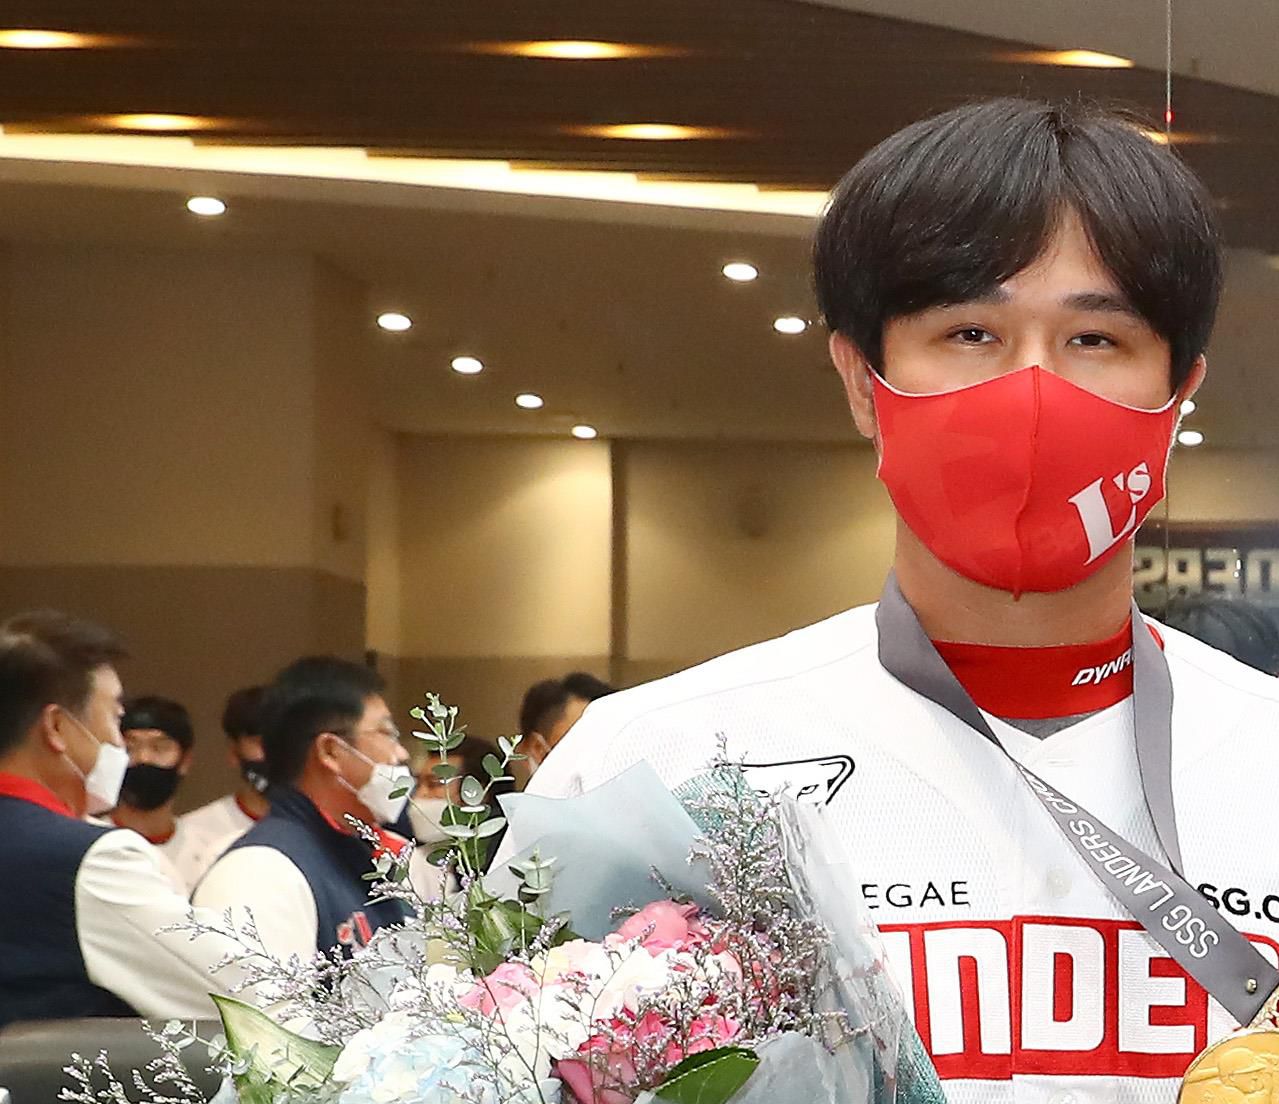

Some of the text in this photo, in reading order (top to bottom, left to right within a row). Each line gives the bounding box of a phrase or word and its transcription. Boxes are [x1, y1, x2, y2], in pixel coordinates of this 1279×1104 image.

[1066, 460, 1152, 567] L's
[1068, 818, 1176, 912] LANDERS
[1160, 903, 1220, 959] SSG
